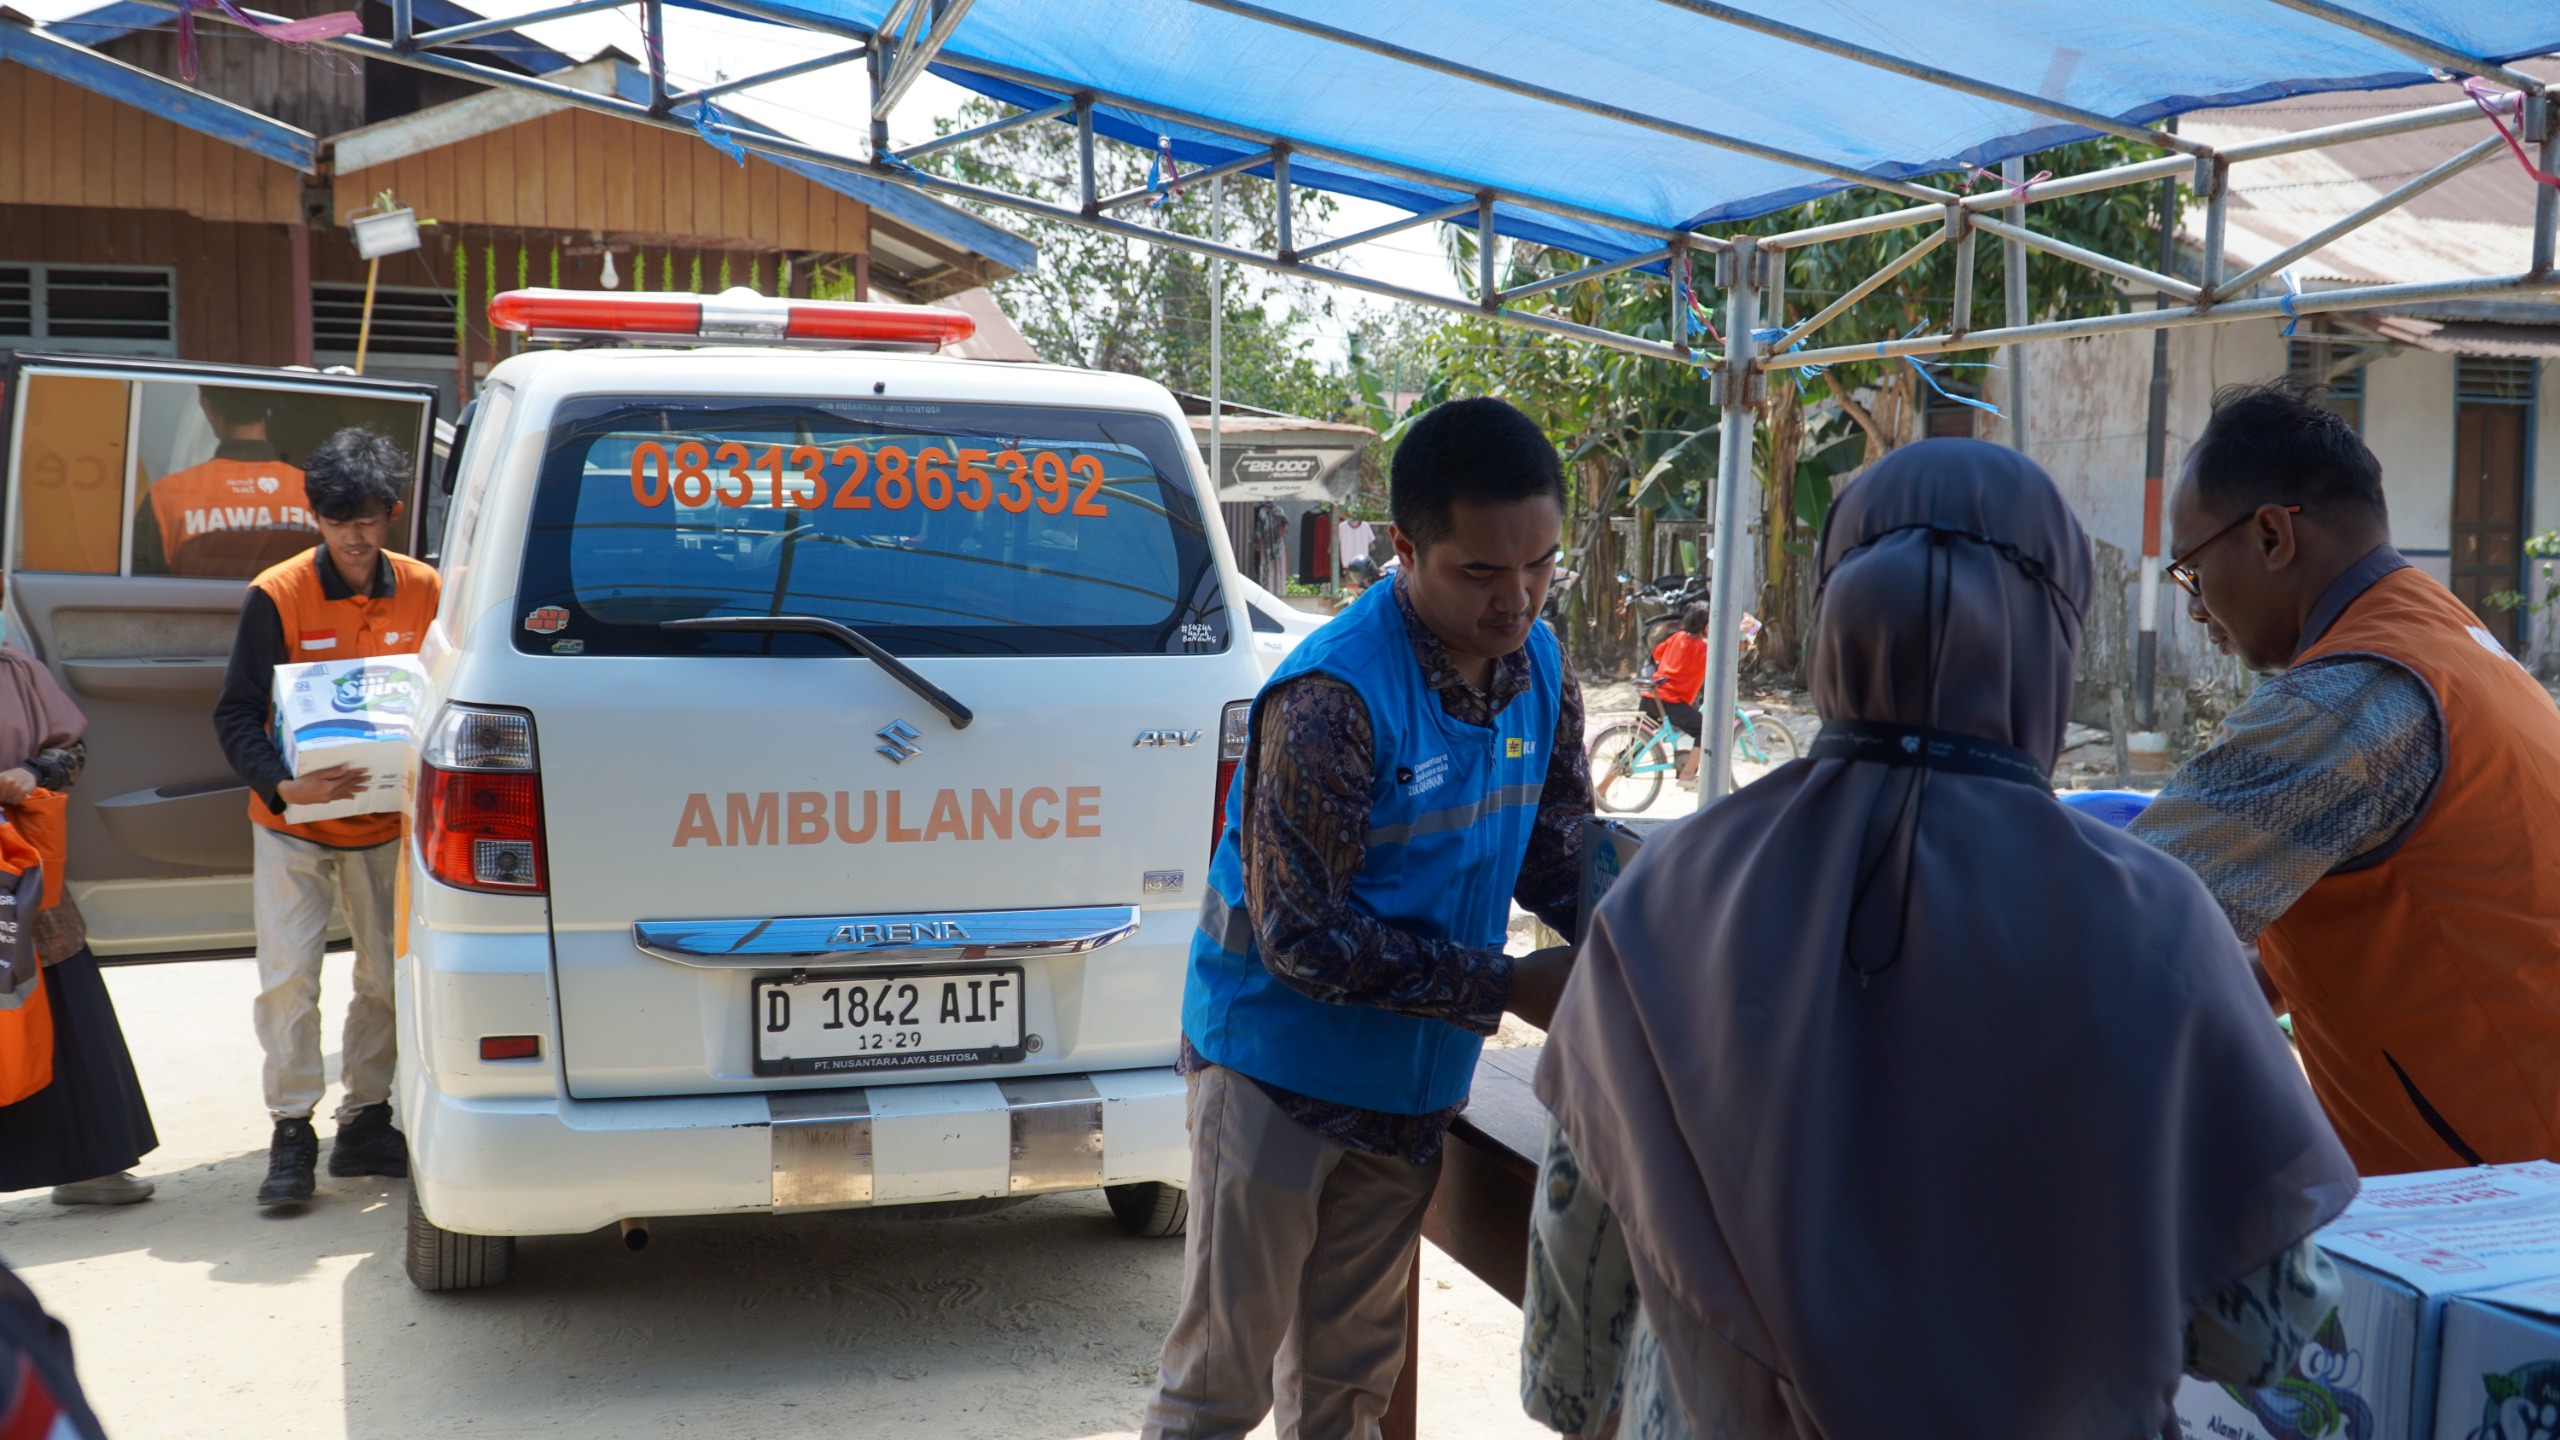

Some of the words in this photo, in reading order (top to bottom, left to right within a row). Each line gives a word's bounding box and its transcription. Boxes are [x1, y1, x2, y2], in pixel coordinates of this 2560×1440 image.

[885, 405, 904, 413] JAYA
[905, 405, 941, 414] SENTOSA
[631, 441, 1108, 517] 083132865392
[1133, 730, 1203, 748] APV
[672, 786, 1101, 847] AMBULANCE
[827, 921, 971, 944] ARENA
[767, 990, 790, 1032] D
[822, 984, 919, 1029] 1842
[940, 979, 1010, 1024] AIF
[814, 1061, 831, 1070] PT.
[832, 1057, 898, 1069] NUSANTARA
[900, 1055, 927, 1065] JAYA
[929, 1053, 979, 1063] SENTOSA
